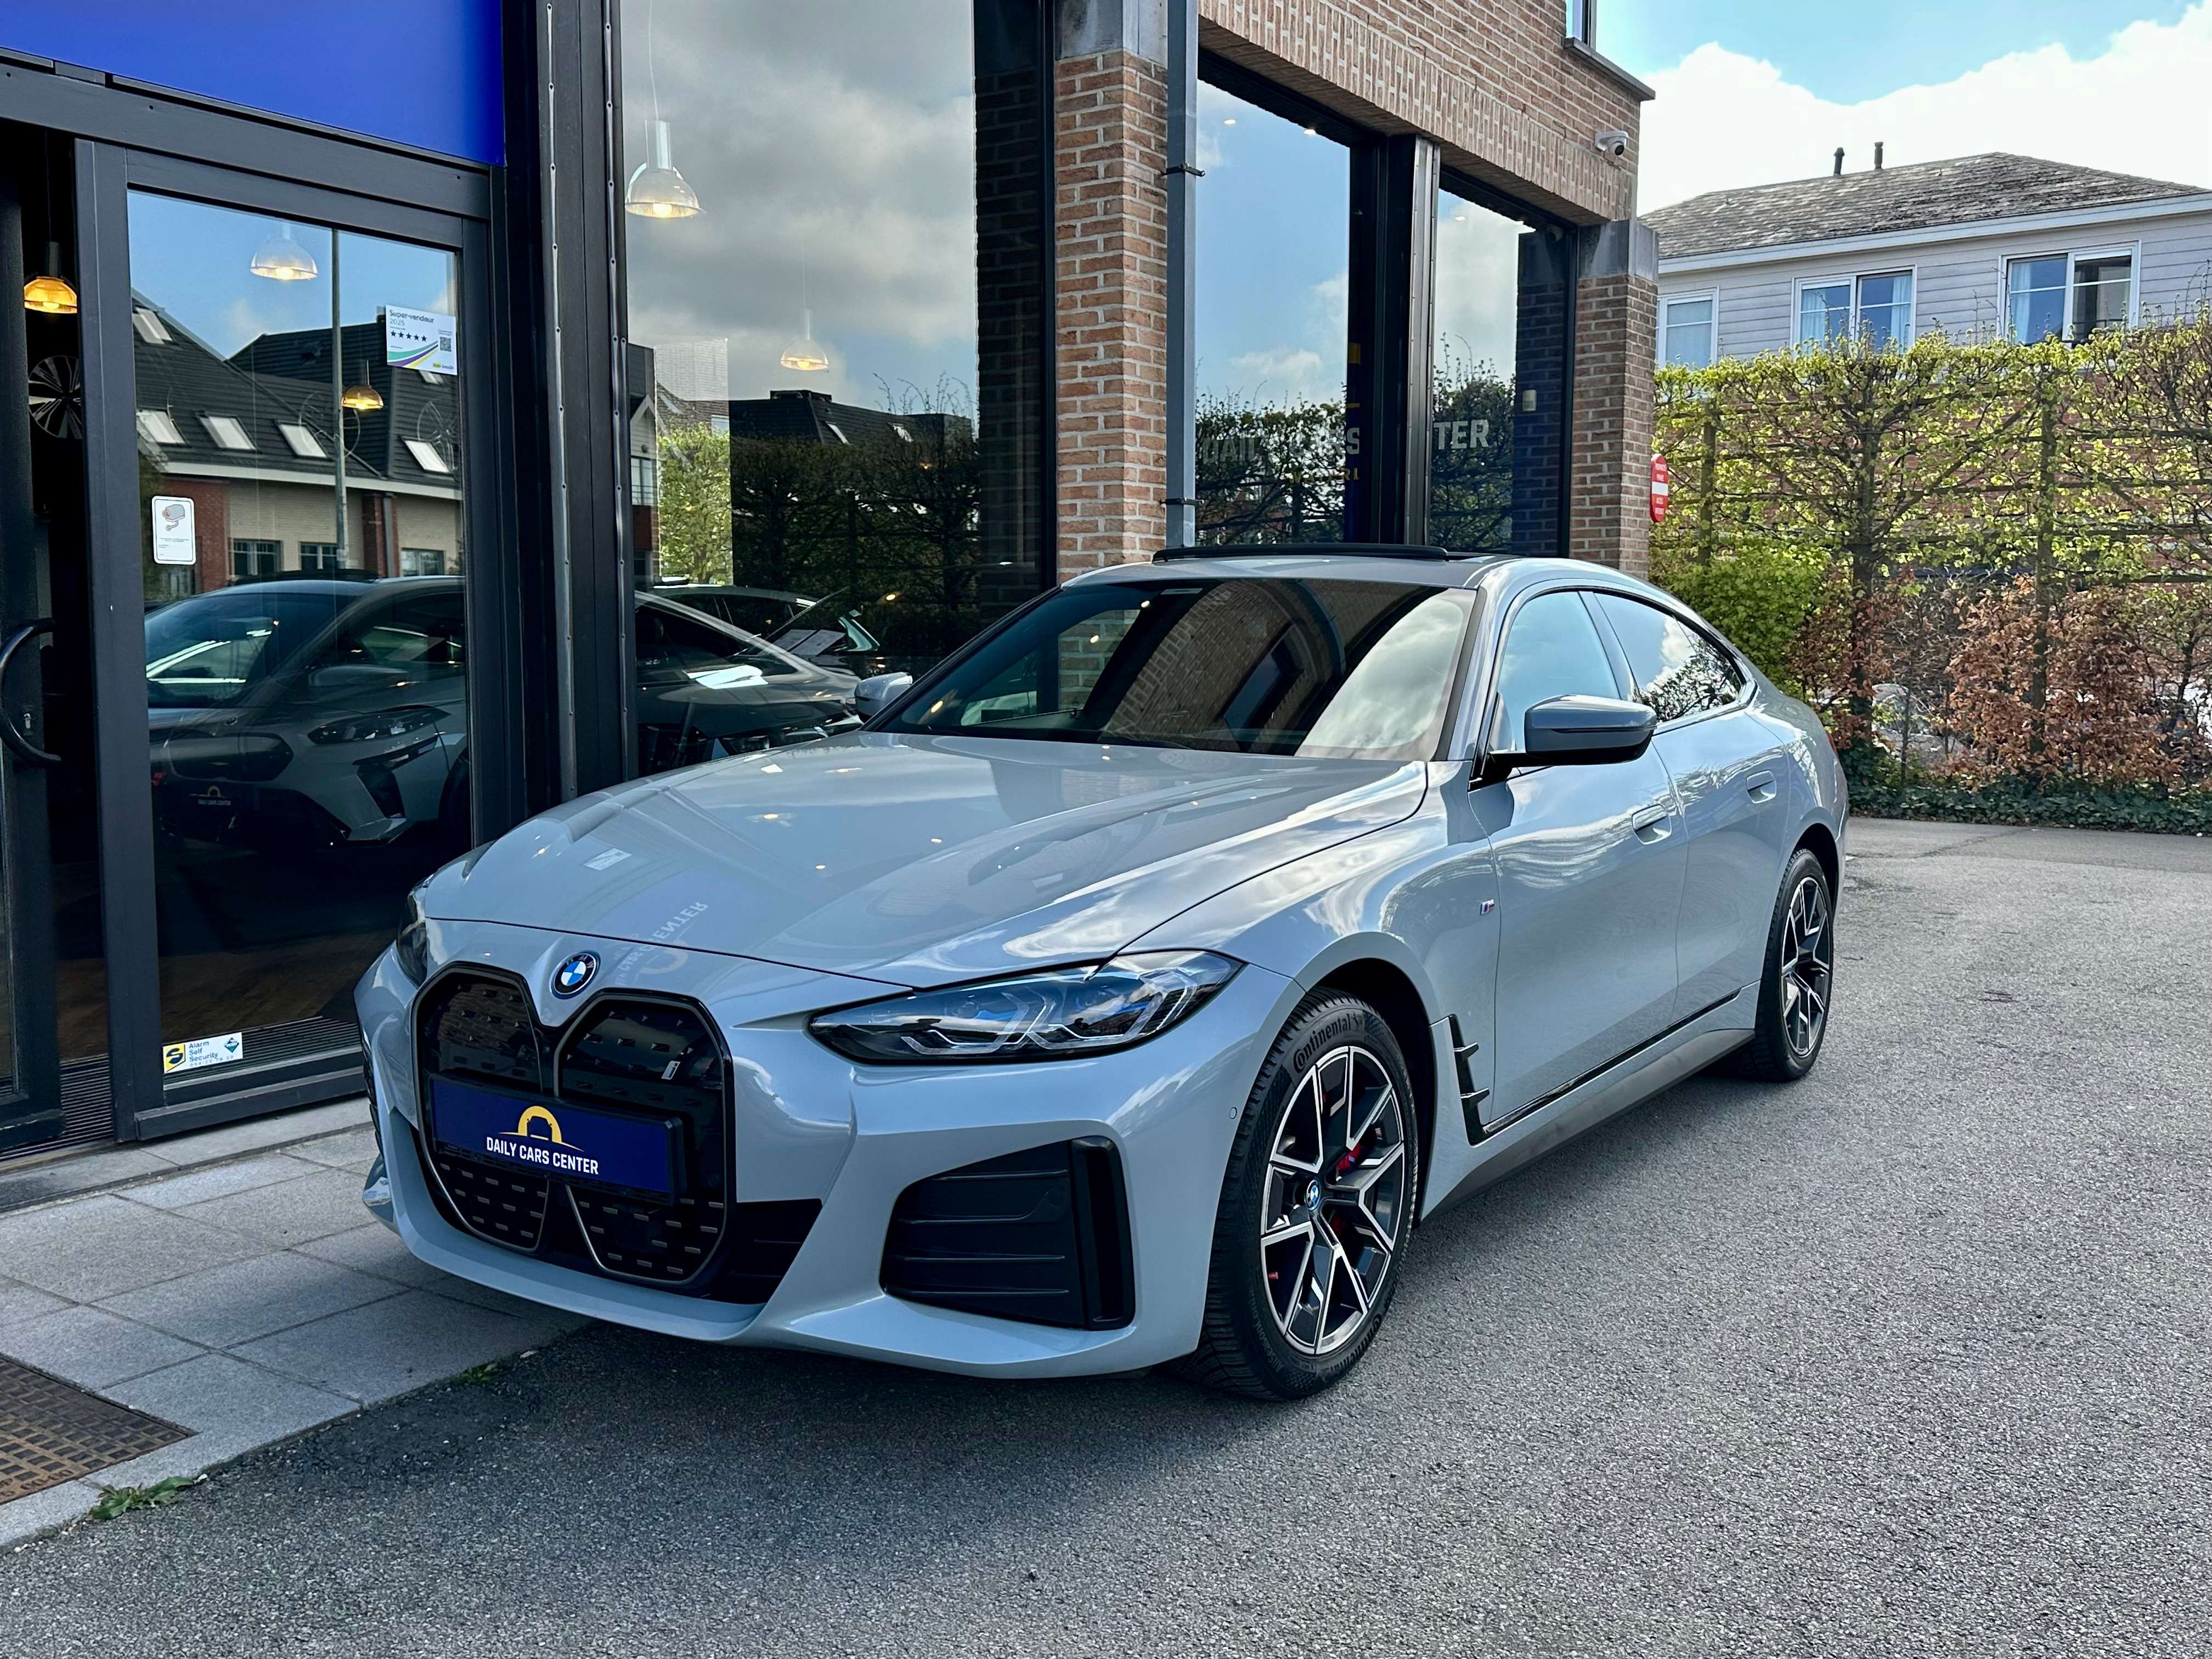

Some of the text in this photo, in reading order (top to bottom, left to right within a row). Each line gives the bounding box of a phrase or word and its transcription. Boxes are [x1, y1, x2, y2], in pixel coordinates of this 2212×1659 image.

[1433, 419, 1489, 450] TER
[189, 1047, 202, 1056] Self
[189, 1052, 218, 1062] Security
[1293, 1013, 1351, 1074] Continental
[486, 1136, 599, 1175] DAILY CARS CENTER
